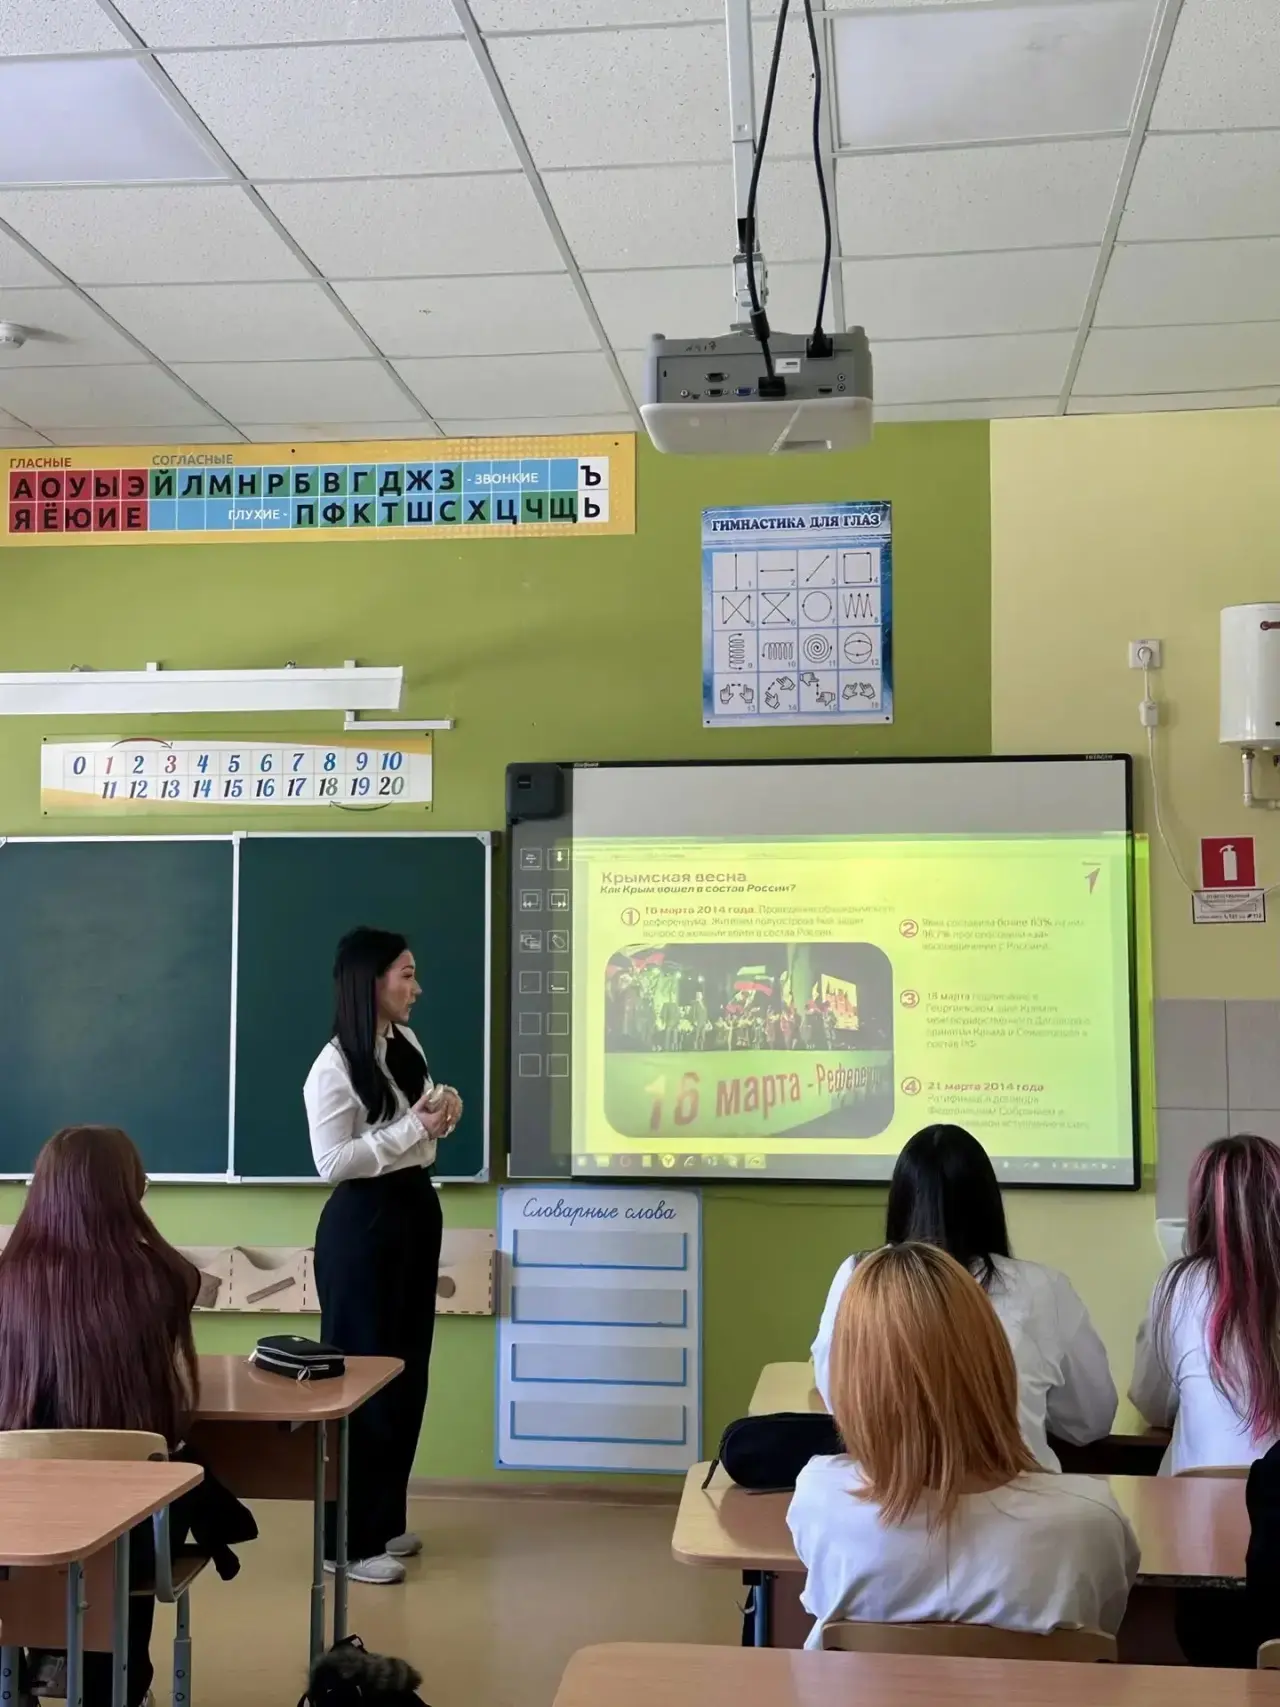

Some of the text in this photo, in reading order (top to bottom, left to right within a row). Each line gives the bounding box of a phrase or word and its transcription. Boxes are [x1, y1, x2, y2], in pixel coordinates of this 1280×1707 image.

[10, 457, 72, 468] ГЛАСНЫЕ
[152, 453, 233, 466] СОГЛАСНЫЕ
[13, 478, 33, 499] А
[41, 477, 61, 499] О
[69, 477, 86, 498] У
[95, 477, 118, 498] Ы
[127, 476, 145, 497] Э
[154, 469, 173, 497] Й
[182, 474, 203, 496] Л
[209, 474, 232, 496] М
[238, 474, 256, 495] Н
[268, 473, 284, 495] Р
[295, 473, 311, 494] Б
[324, 472, 340, 494] В
[353, 471, 368, 493] Г
[378, 470, 402, 497] Д
[406, 470, 433, 491] Ж
[439, 469, 455, 491] З
[475, 473, 538, 485] ЗВОНКИЕ
[580, 465, 602, 486] Ъ
[14, 508, 31, 530] Я
[43, 502, 58, 529] Ё
[65, 507, 92, 529] Ю
[98, 507, 116, 528] И
[127, 507, 141, 528] Е
[228, 510, 280, 520] ГЛУХИЕ
[296, 504, 314, 525] П
[322, 502, 346, 525] Ф
[353, 503, 371, 524] К
[381, 502, 399, 523] Т
[407, 501, 433, 523] Ш
[439, 500, 457, 522] С
[467, 499, 487, 521] Х
[497, 499, 518, 525] Ц
[525, 498, 543, 520] Ч
[549, 497, 578, 524] Щ
[584, 497, 601, 518] Ь
[712, 514, 880, 531] ГИМНАСТИКА ДЛЯ ГЛАЗ
[73, 751, 402, 774] 0 1 2 3 4 5 6 7 8 9 10
[102, 776, 404, 799] 11 12 13 14 15 16 17 18 19 20
[602, 872, 747, 885] Крымская весна
[623, 886, 655, 894] Крым
[747, 884, 796, 892] России?
[697, 906, 725, 914] 2014
[927, 1082, 1044, 1092] 21 марта 2014 года
[715, 1072, 800, 1120] марта
[523, 1198, 677, 1226] Словарные слова
